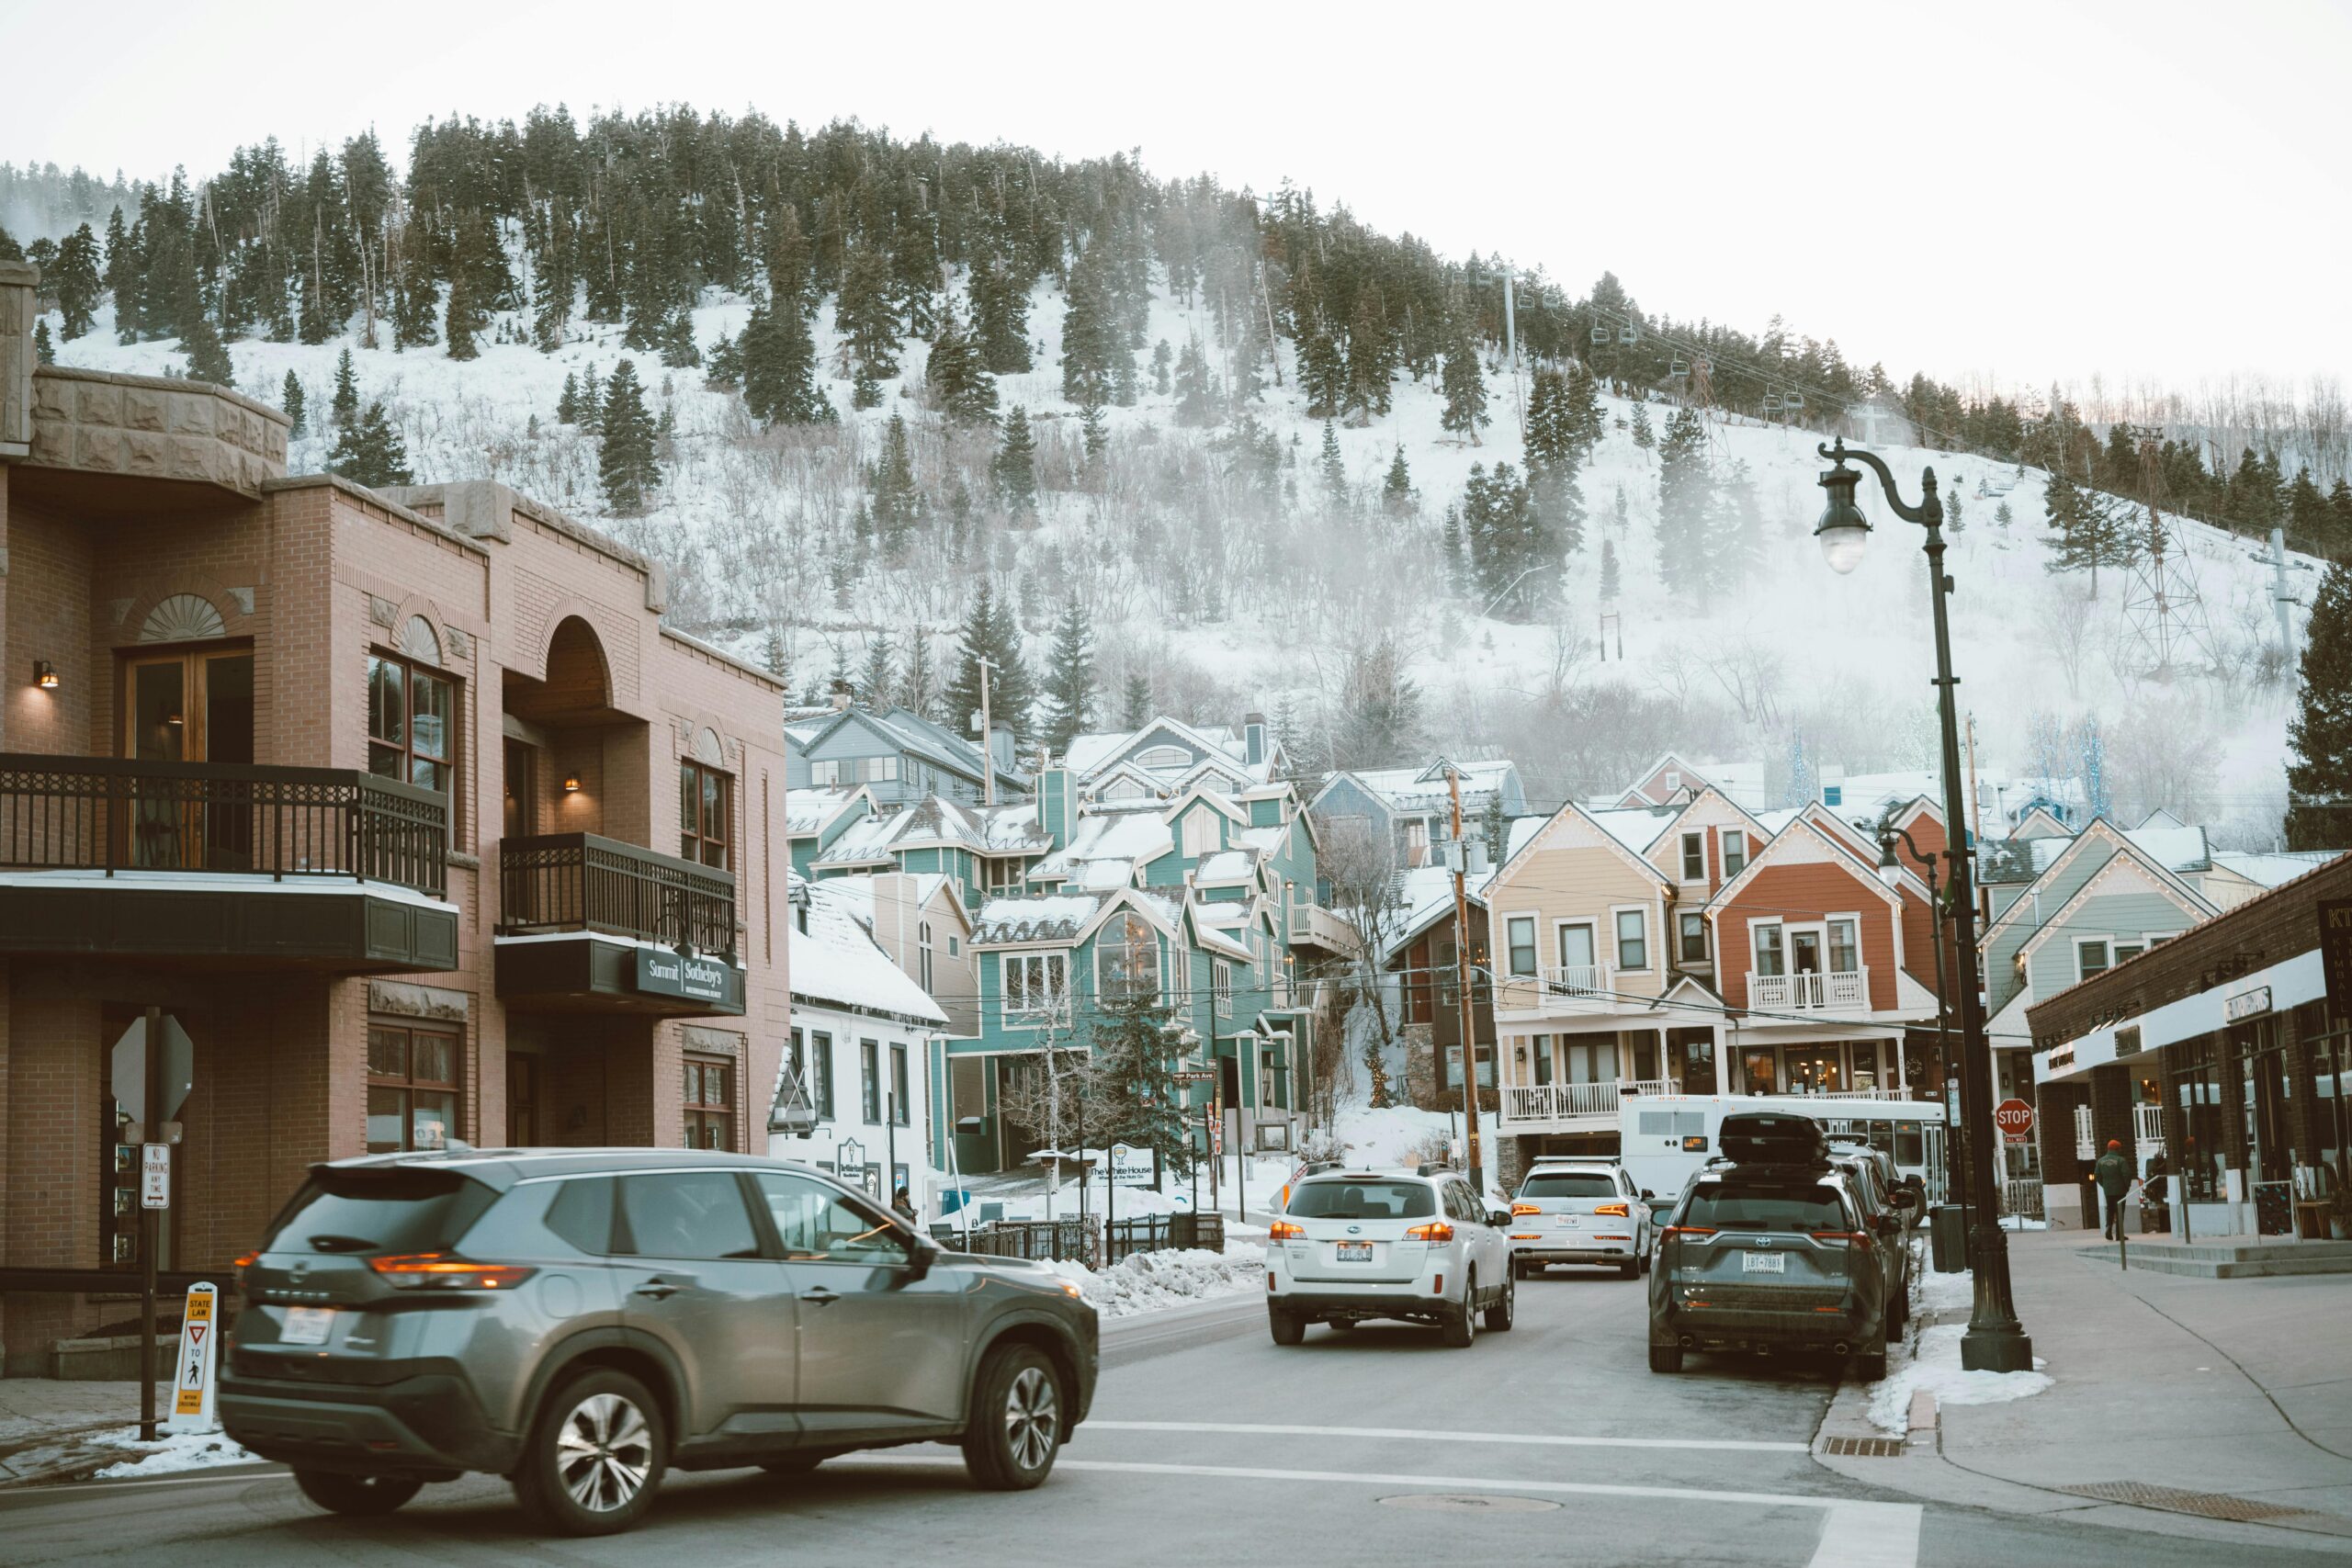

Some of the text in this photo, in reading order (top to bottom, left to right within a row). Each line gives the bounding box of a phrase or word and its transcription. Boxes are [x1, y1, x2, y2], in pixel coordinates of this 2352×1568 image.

[649, 959, 722, 987] Summit Sotheby's
[1998, 1110, 2030, 1123] STOP
[153, 1148, 160, 1160] NO
[145, 1162, 167, 1174] PARKING
[151, 1185, 162, 1193] TIME
[189, 1300, 210, 1308] STATE
[191, 1348, 200, 1358] TO
